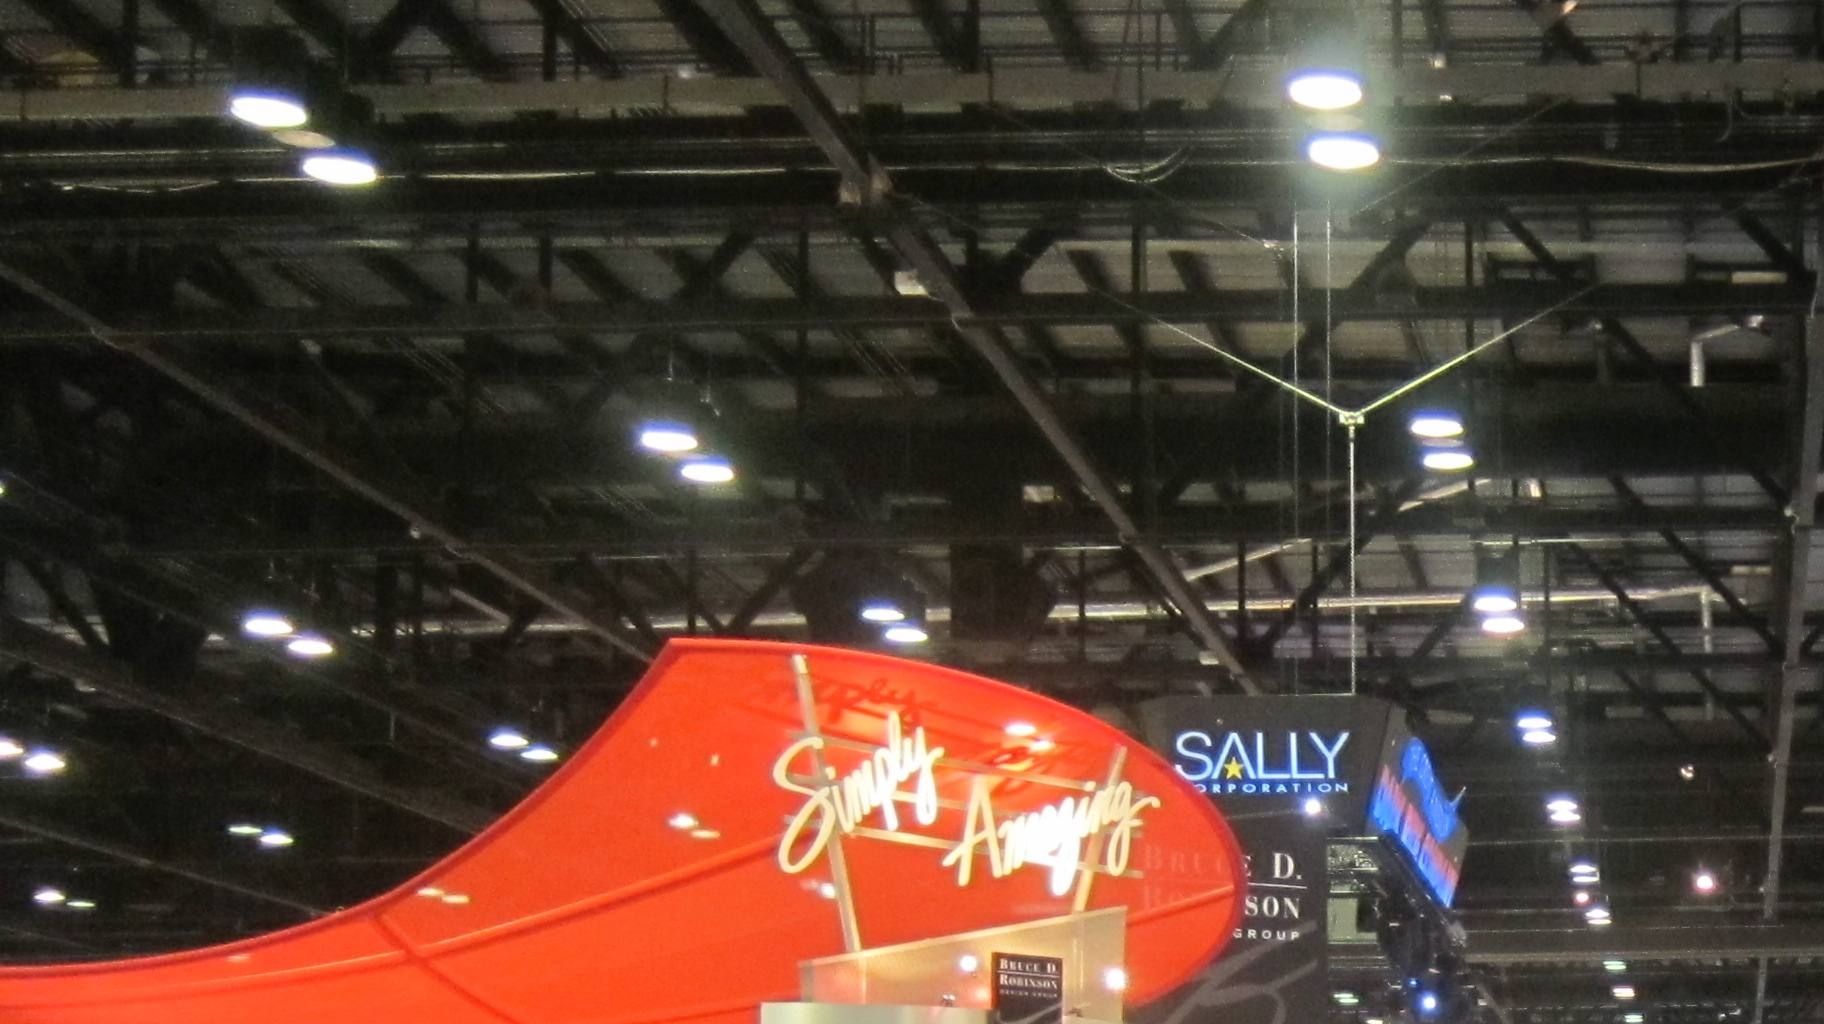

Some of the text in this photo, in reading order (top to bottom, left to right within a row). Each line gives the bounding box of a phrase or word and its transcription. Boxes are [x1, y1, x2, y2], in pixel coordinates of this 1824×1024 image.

[1175, 731, 1350, 781] SALLY
[1193, 782, 1349, 793] ORPORATION
[772, 709, 1161, 896] Simply Amazing
[1232, 928, 1300, 941] GROUP
[1000, 973, 1058, 989] ROBINSON
